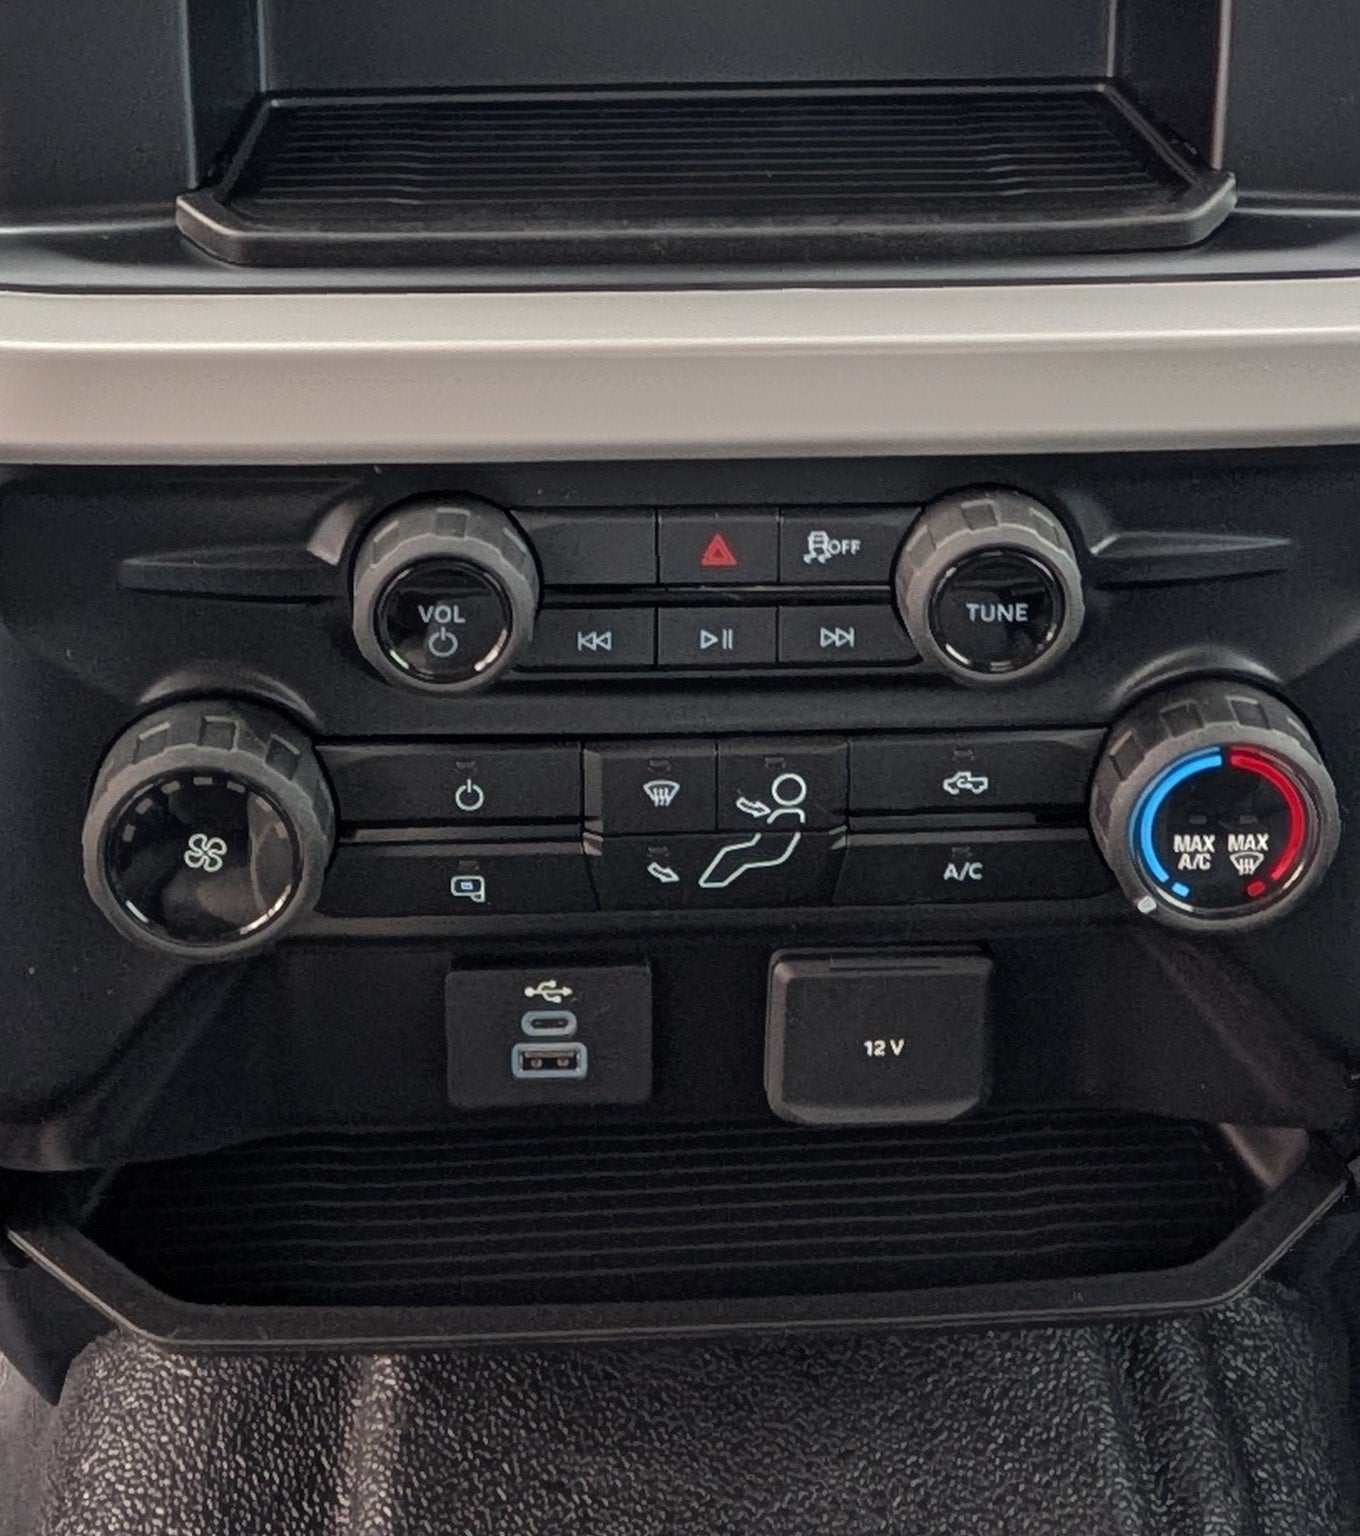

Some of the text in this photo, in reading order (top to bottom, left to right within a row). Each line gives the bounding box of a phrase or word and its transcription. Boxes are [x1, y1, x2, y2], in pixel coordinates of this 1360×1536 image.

[828, 539, 861, 555] OFF
[418, 603, 466, 624] VOL
[965, 602, 1029, 623] TUNE
[1173, 834, 1216, 853] MAX
[1227, 833, 1270, 852] MAX
[1177, 852, 1212, 871] A/C
[943, 861, 983, 882] A/C
[863, 1038, 905, 1057] 12 V
